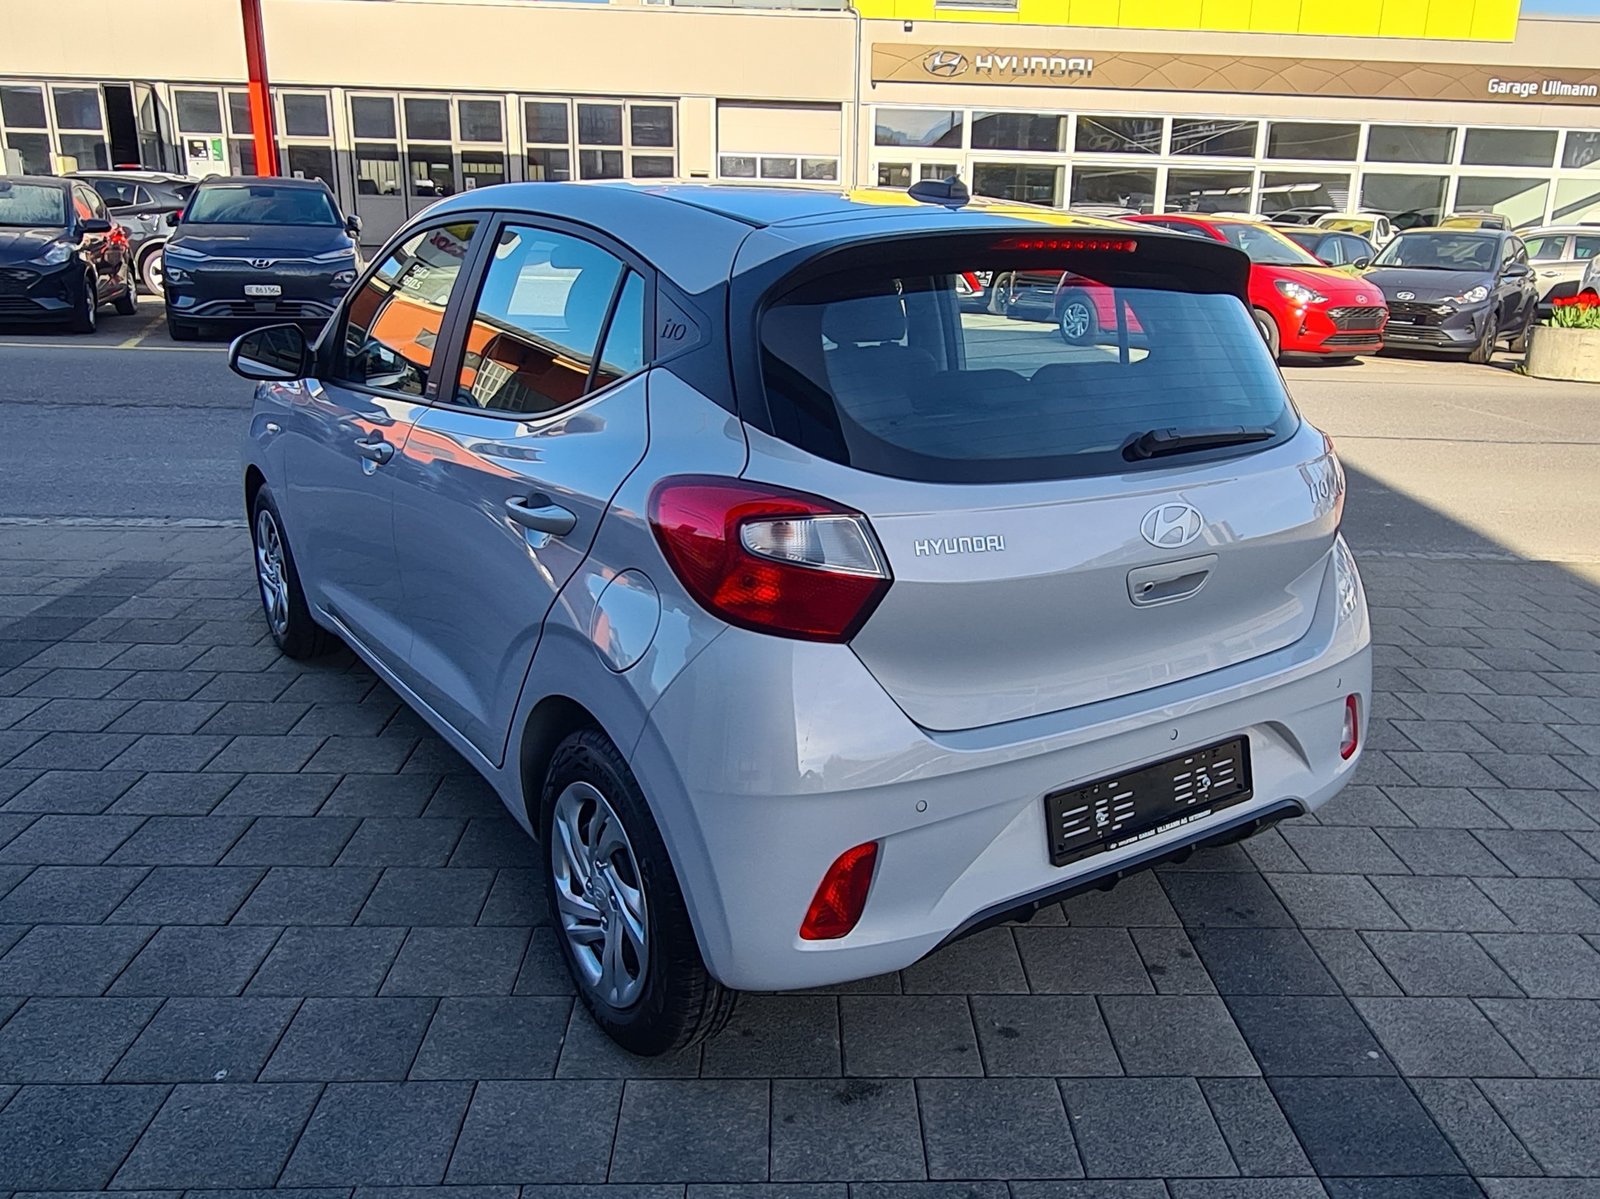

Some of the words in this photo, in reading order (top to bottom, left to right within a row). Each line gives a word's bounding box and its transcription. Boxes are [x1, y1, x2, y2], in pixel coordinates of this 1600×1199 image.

[975, 54, 1093, 77] HYUNDAI
[1487, 78, 1539, 98] Garage
[1541, 80, 1598, 97] Ullmann
[660, 318, 687, 341] i10
[914, 535, 1005, 556] HYUNDAI
